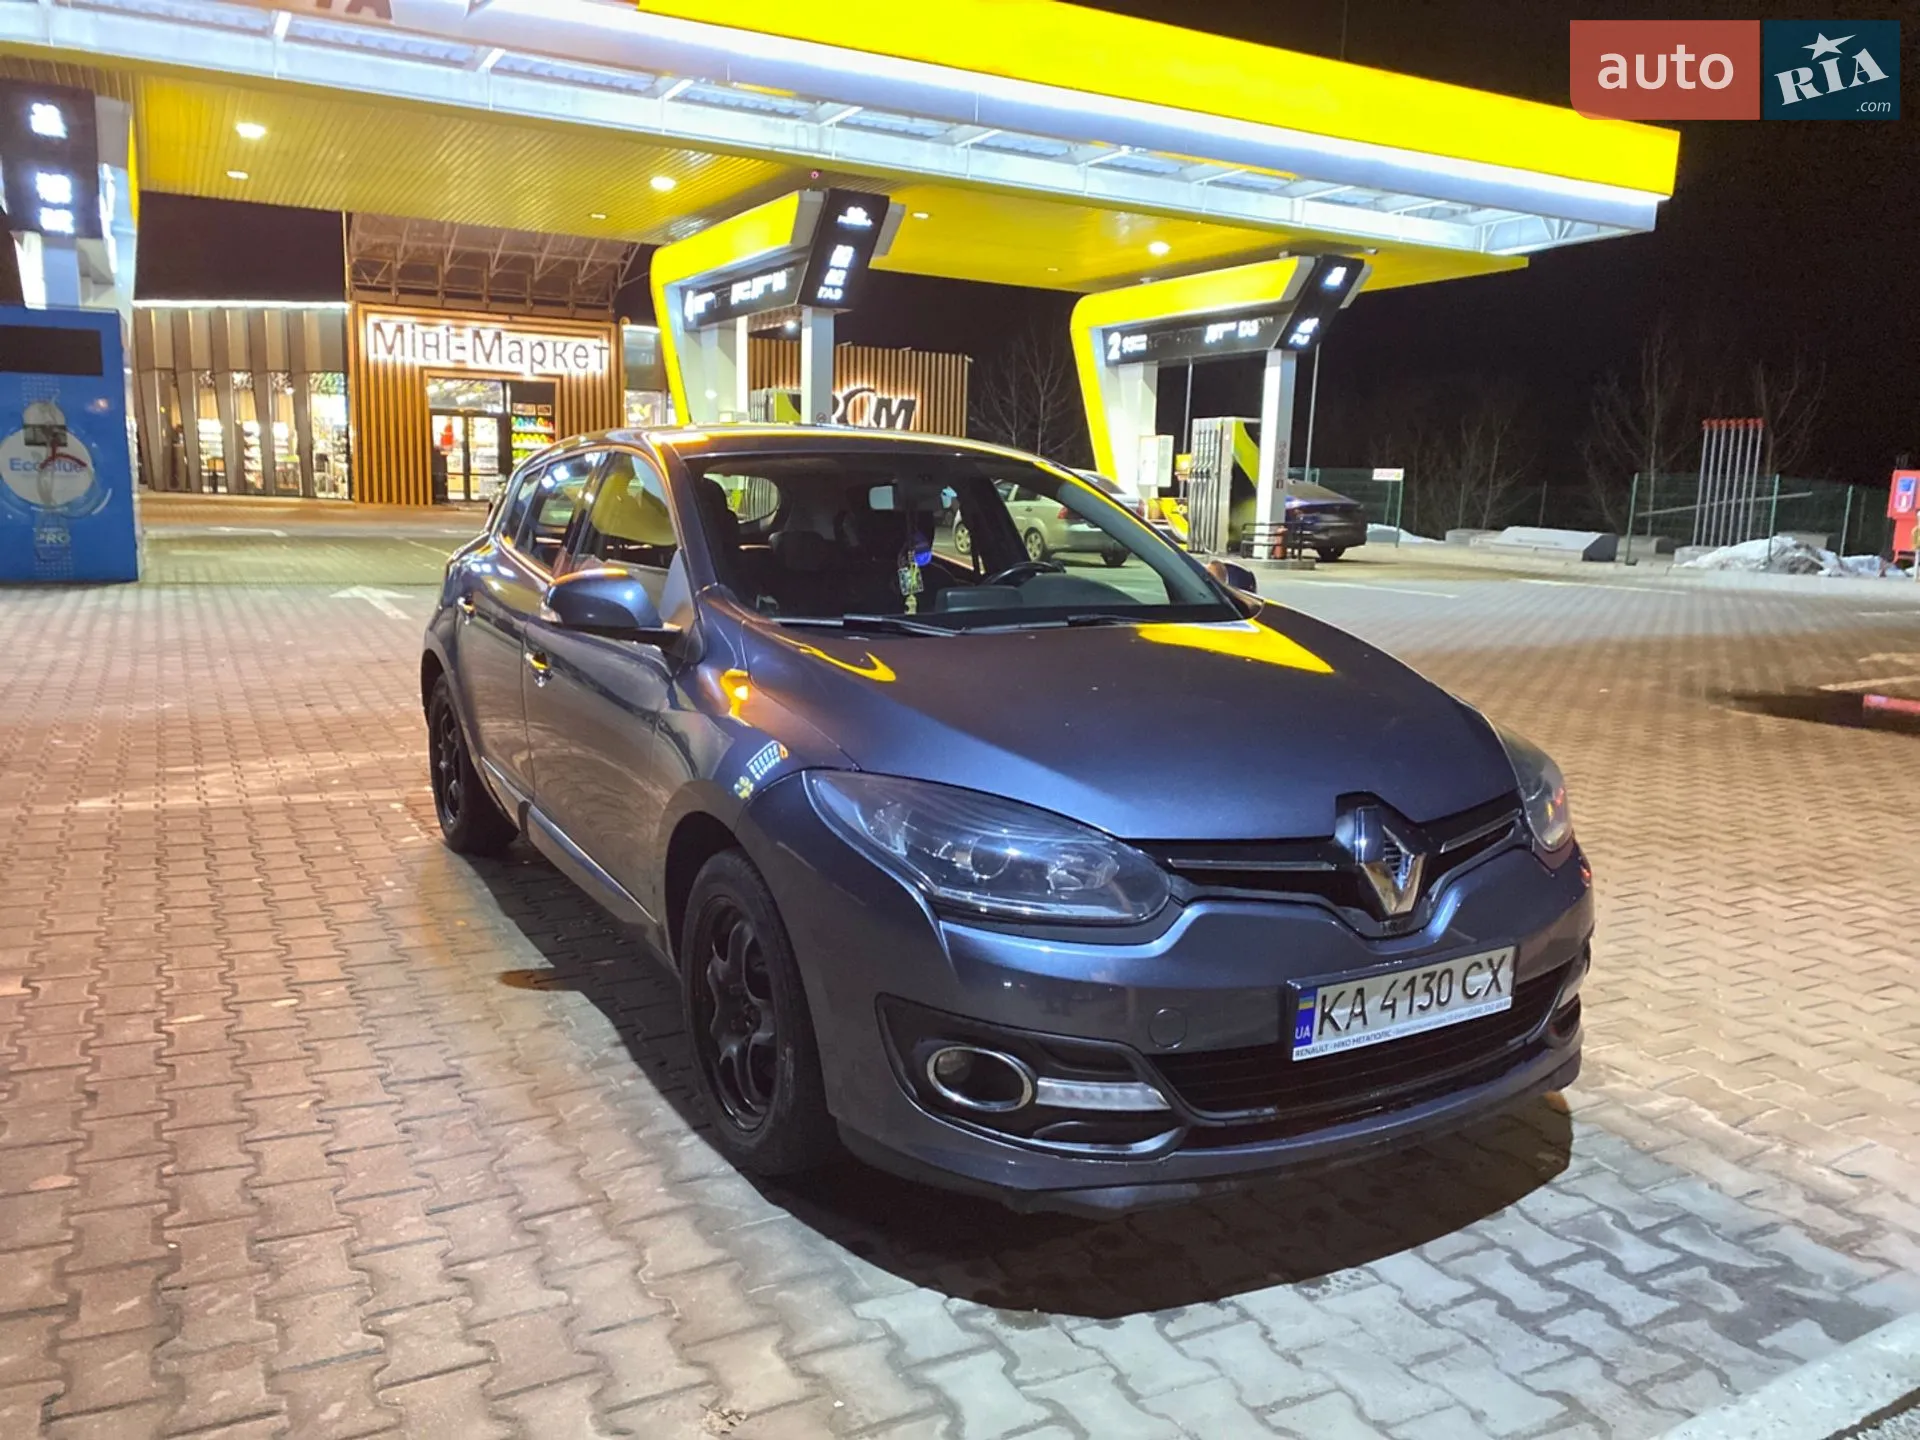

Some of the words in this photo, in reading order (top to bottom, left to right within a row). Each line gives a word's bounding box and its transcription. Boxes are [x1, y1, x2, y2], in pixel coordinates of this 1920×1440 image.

[372, 322, 610, 374] Міні-Маркет
[1318, 987, 1368, 1036] KA
[1380, 968, 1454, 1020] 4130
[1294, 1026, 1311, 1040] UA
[1295, 1044, 1328, 1057] RENAULT
